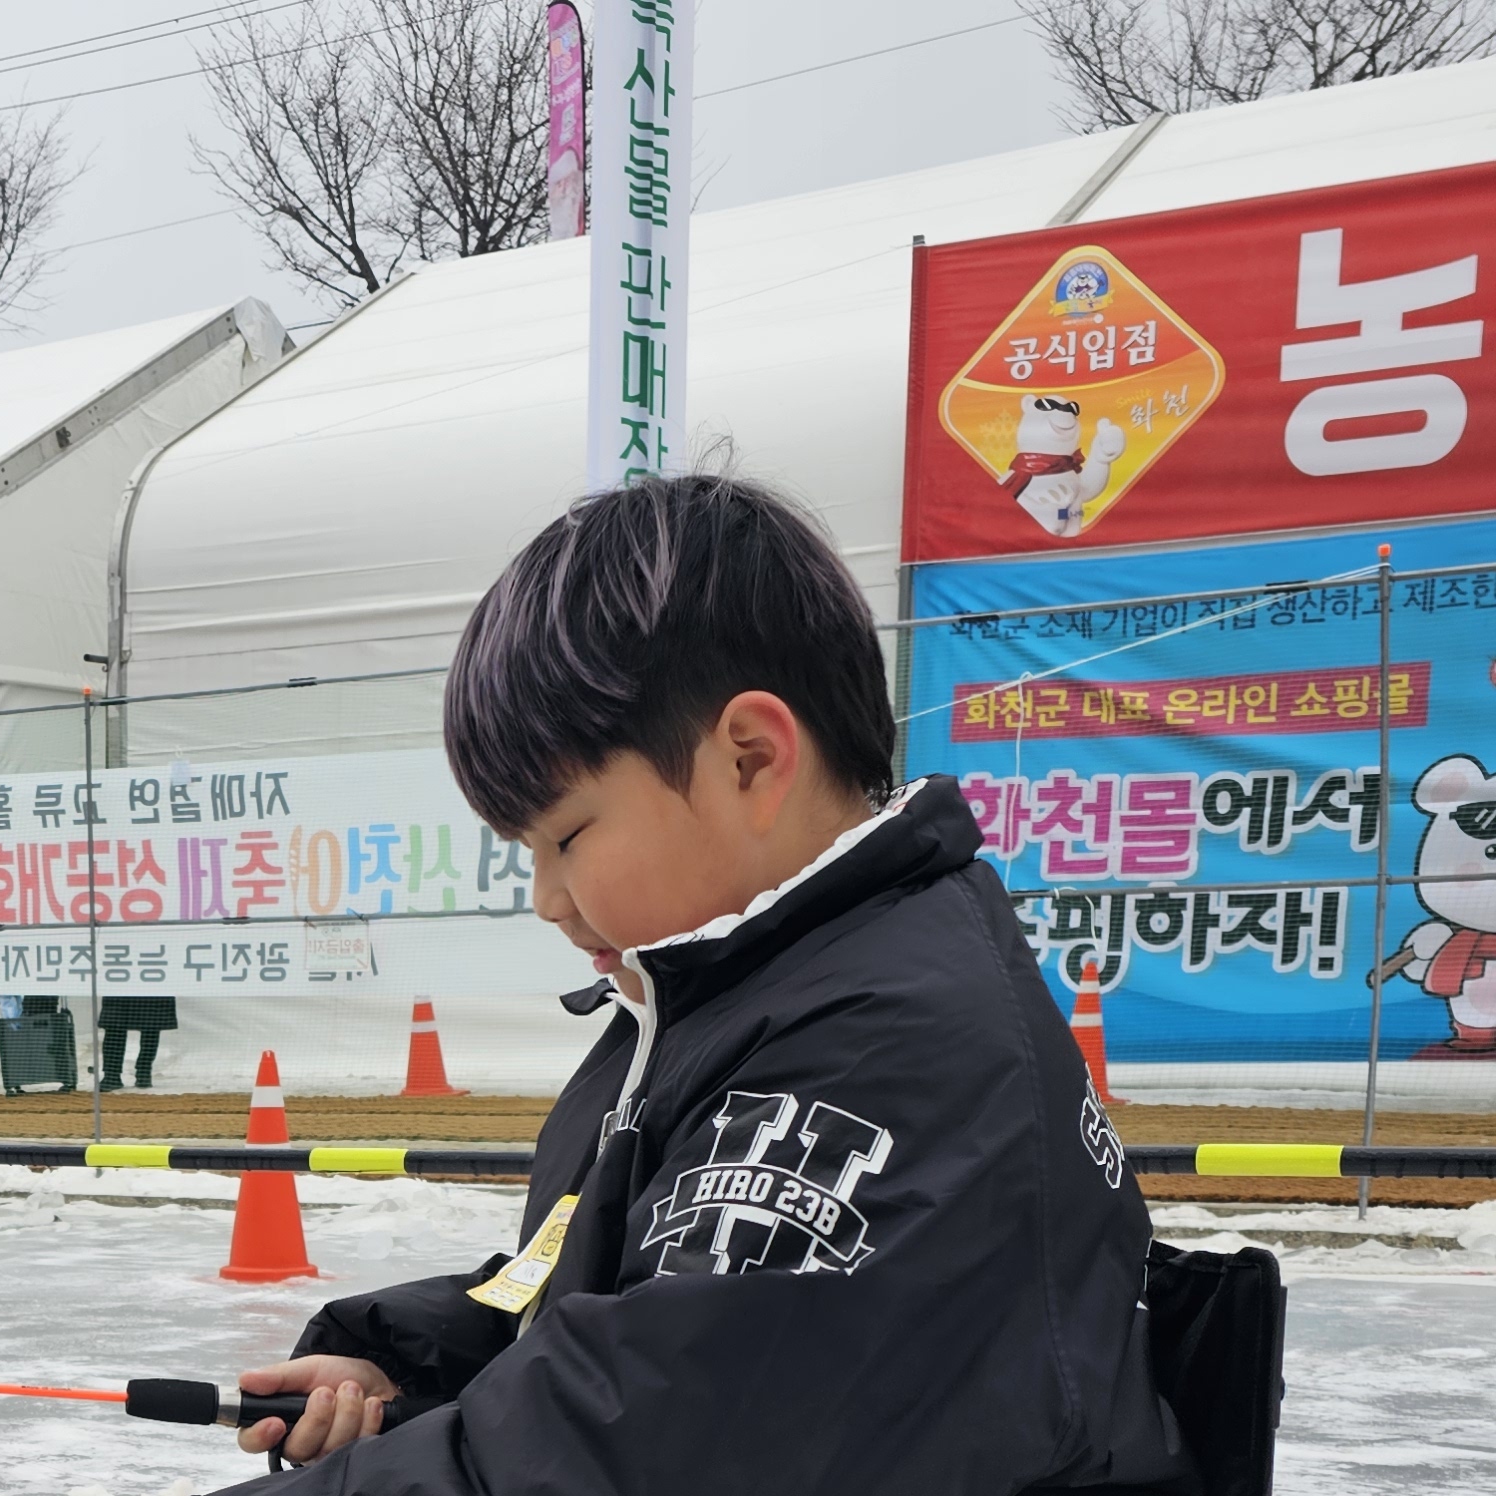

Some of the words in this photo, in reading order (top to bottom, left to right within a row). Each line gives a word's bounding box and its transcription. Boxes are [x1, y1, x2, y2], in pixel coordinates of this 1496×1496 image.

[1003, 319, 1157, 381] 공식입점
[1280, 227, 1485, 478] 농
[1102, 600, 1189, 638] 기업이
[1197, 593, 1257, 631] 직접
[963, 685, 1071, 730] 화천군
[1082, 683, 1152, 725] 대표
[1162, 680, 1279, 727] 온라인
[1290, 672, 1415, 722] 쇼핑몰
[960, 771, 1381, 877] 화천몰에서
[691, 1168, 775, 1204] HIRO
